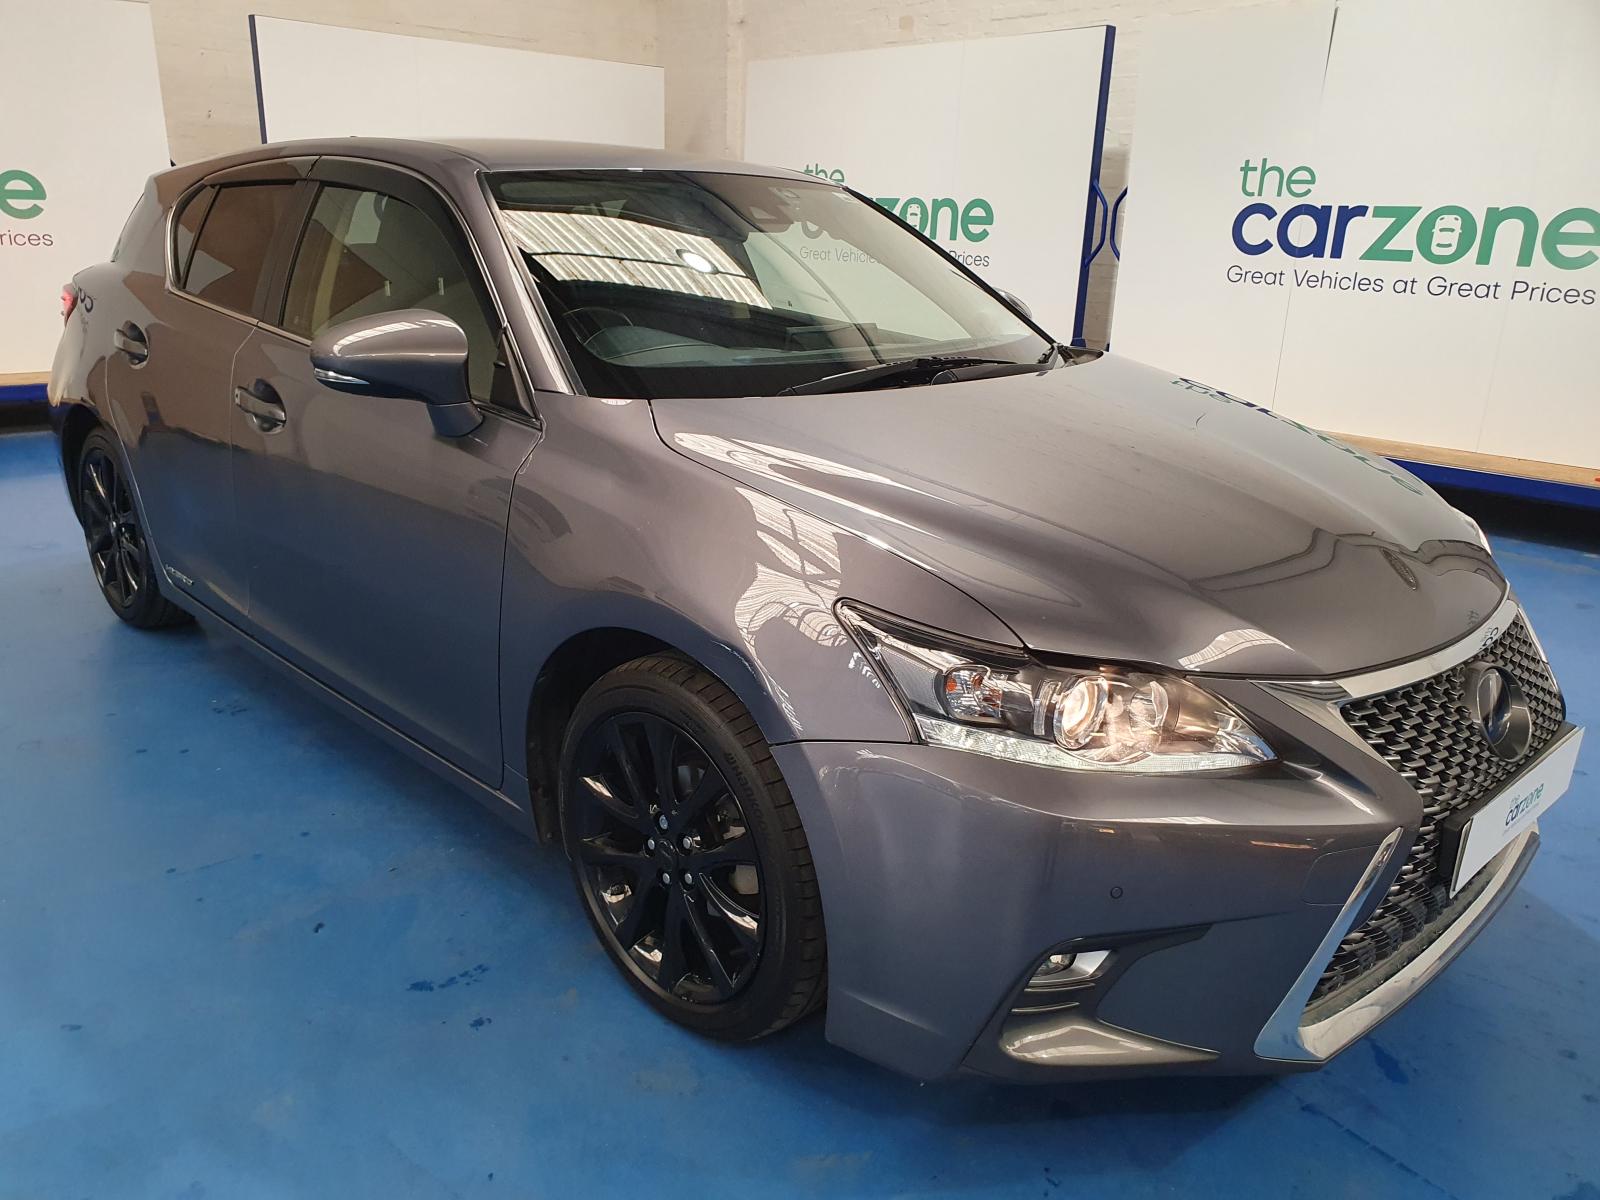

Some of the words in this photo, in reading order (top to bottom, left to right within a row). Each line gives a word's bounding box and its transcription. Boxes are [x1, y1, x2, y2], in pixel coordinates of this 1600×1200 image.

[1239, 157, 1317, 198] the
[0, 229, 54, 247] rices
[801, 196, 994, 243] zone
[1231, 202, 1600, 271] carzone
[799, 246, 831, 262] Great
[834, 247, 881, 265] Vehicle
[1226, 264, 1286, 287] Great
[1293, 269, 1385, 293] Vehicles
[1392, 277, 1418, 295] at
[1426, 275, 1502, 300] Great
[1510, 280, 1597, 306] Prices
